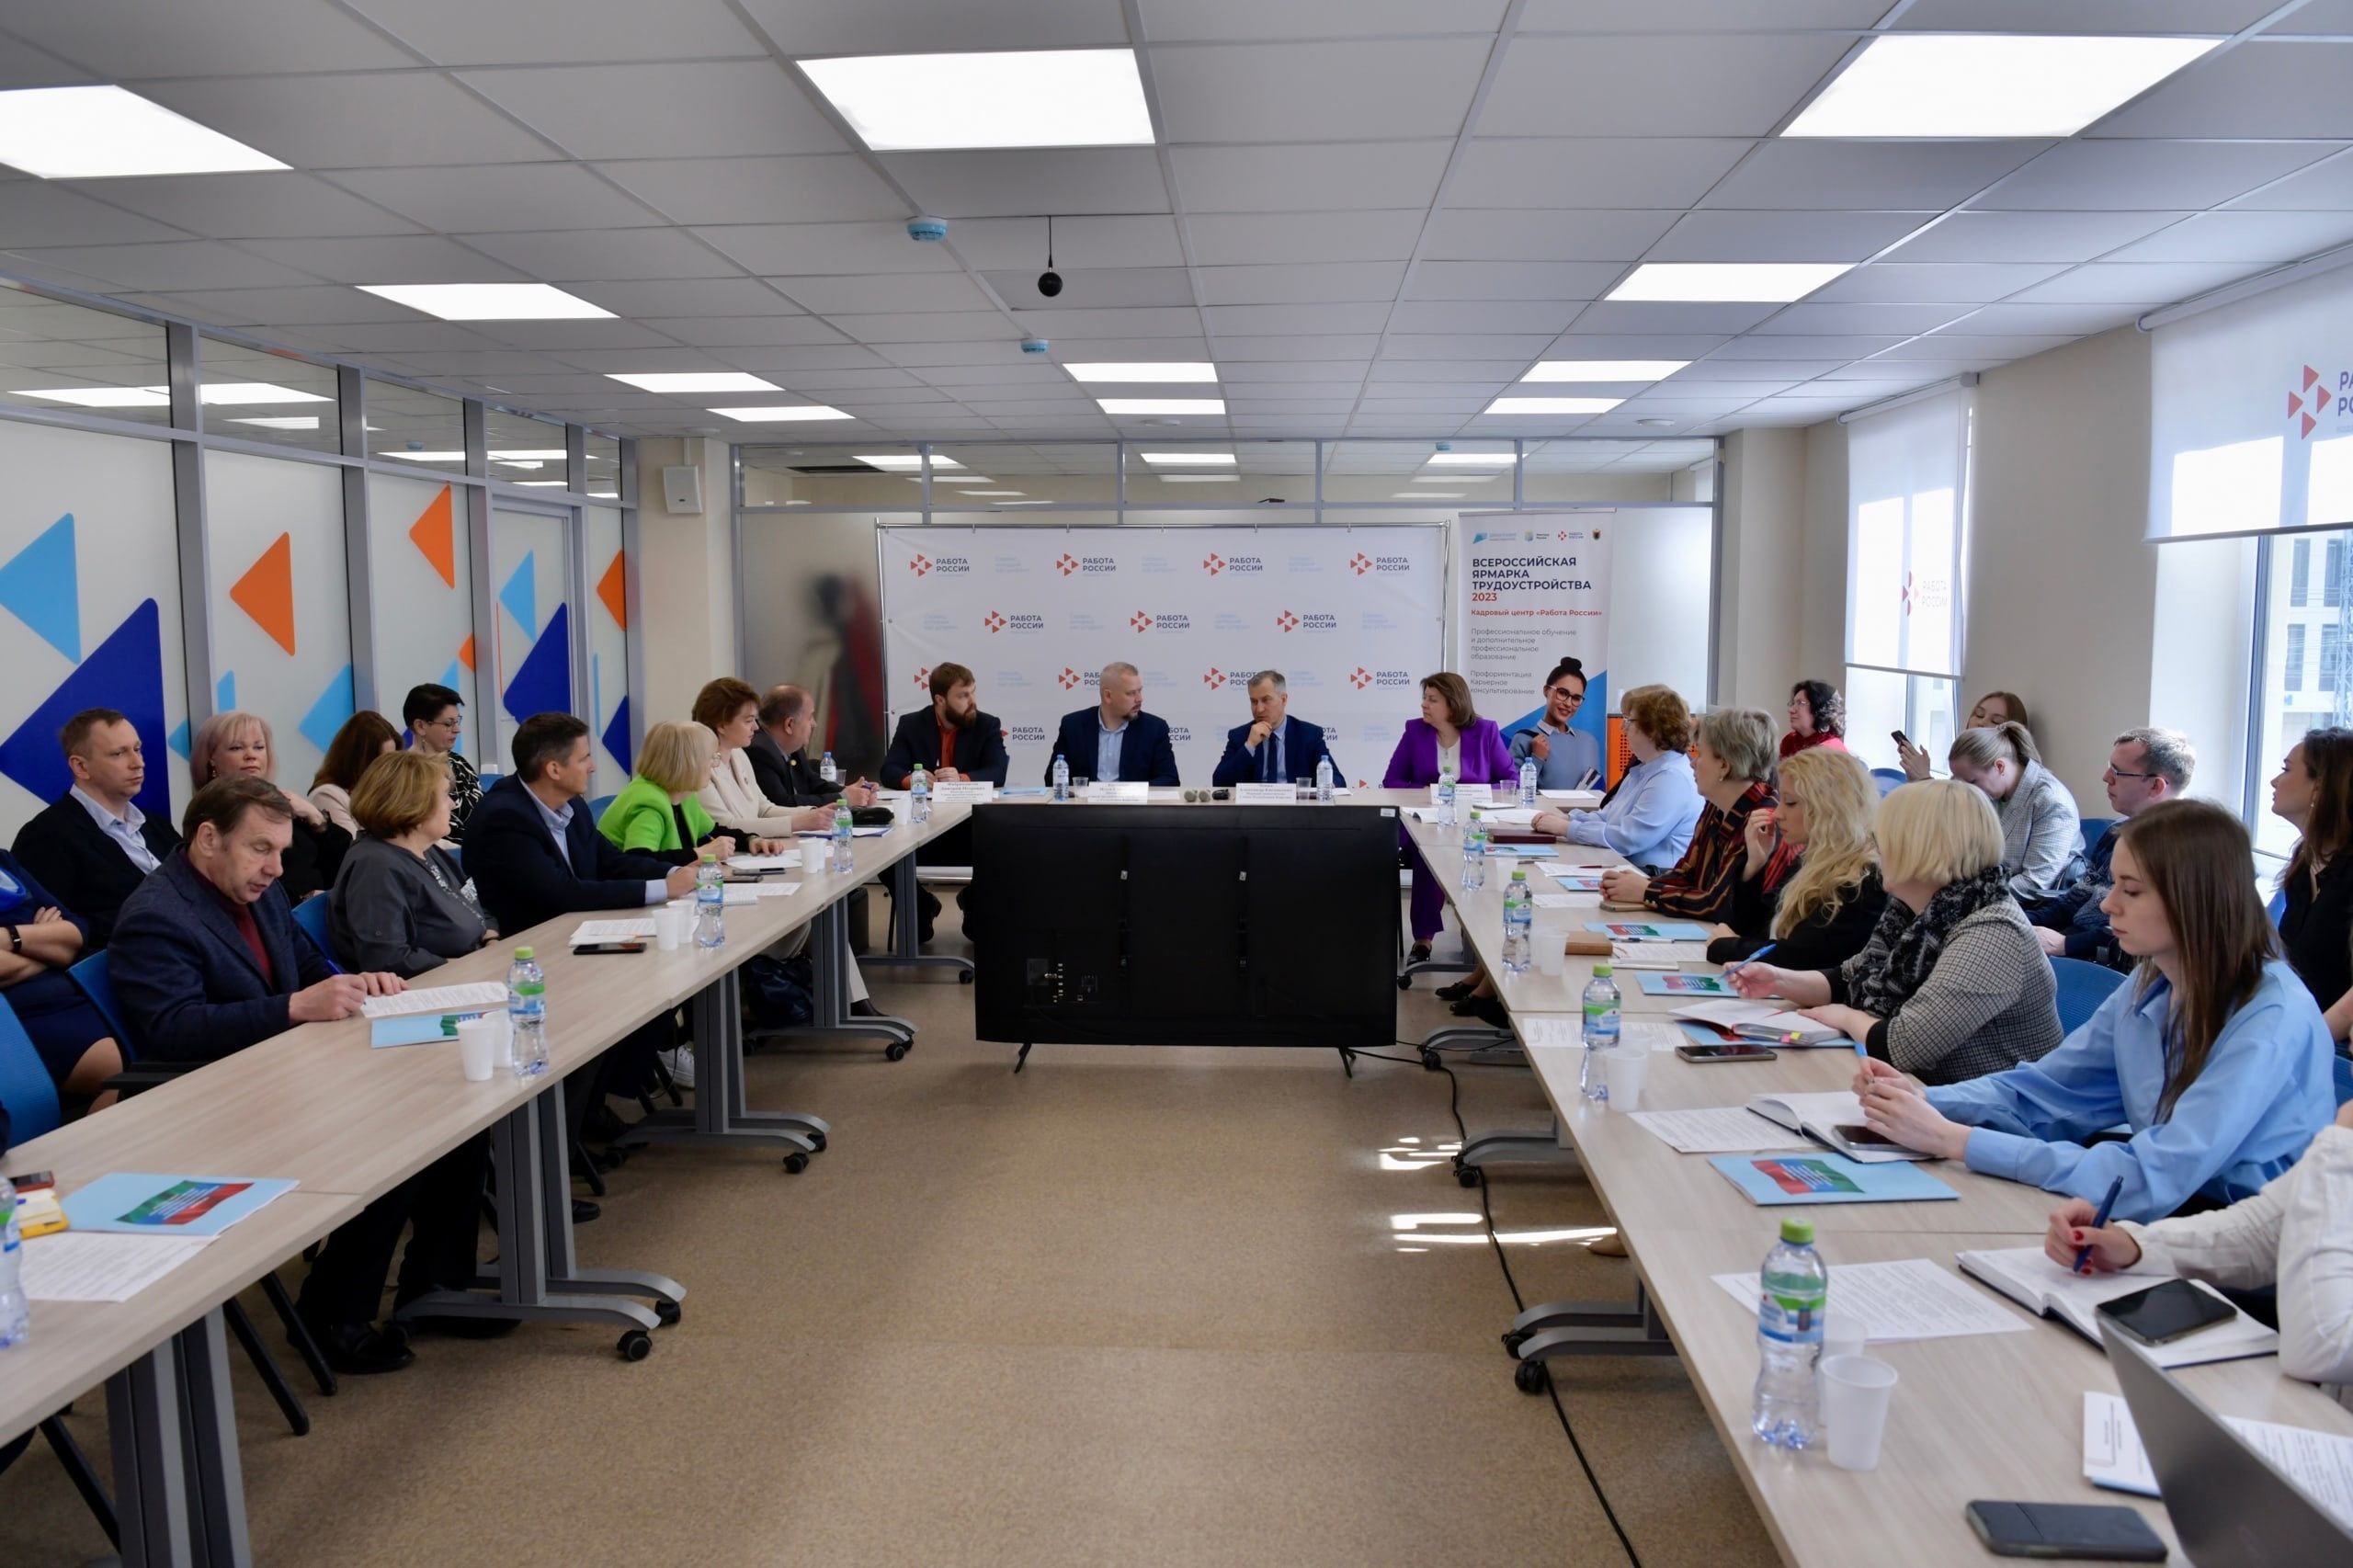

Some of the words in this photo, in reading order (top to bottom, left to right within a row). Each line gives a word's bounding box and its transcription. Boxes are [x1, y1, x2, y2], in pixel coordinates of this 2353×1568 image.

[1472, 556, 1576, 567] ВСЕРОССИЙСКАЯ
[1472, 569, 1529, 579] ЯРМАРКА
[1472, 579, 1592, 591] ТРУДОУСТРОЙСТВА
[1472, 593, 1497, 601] 2023
